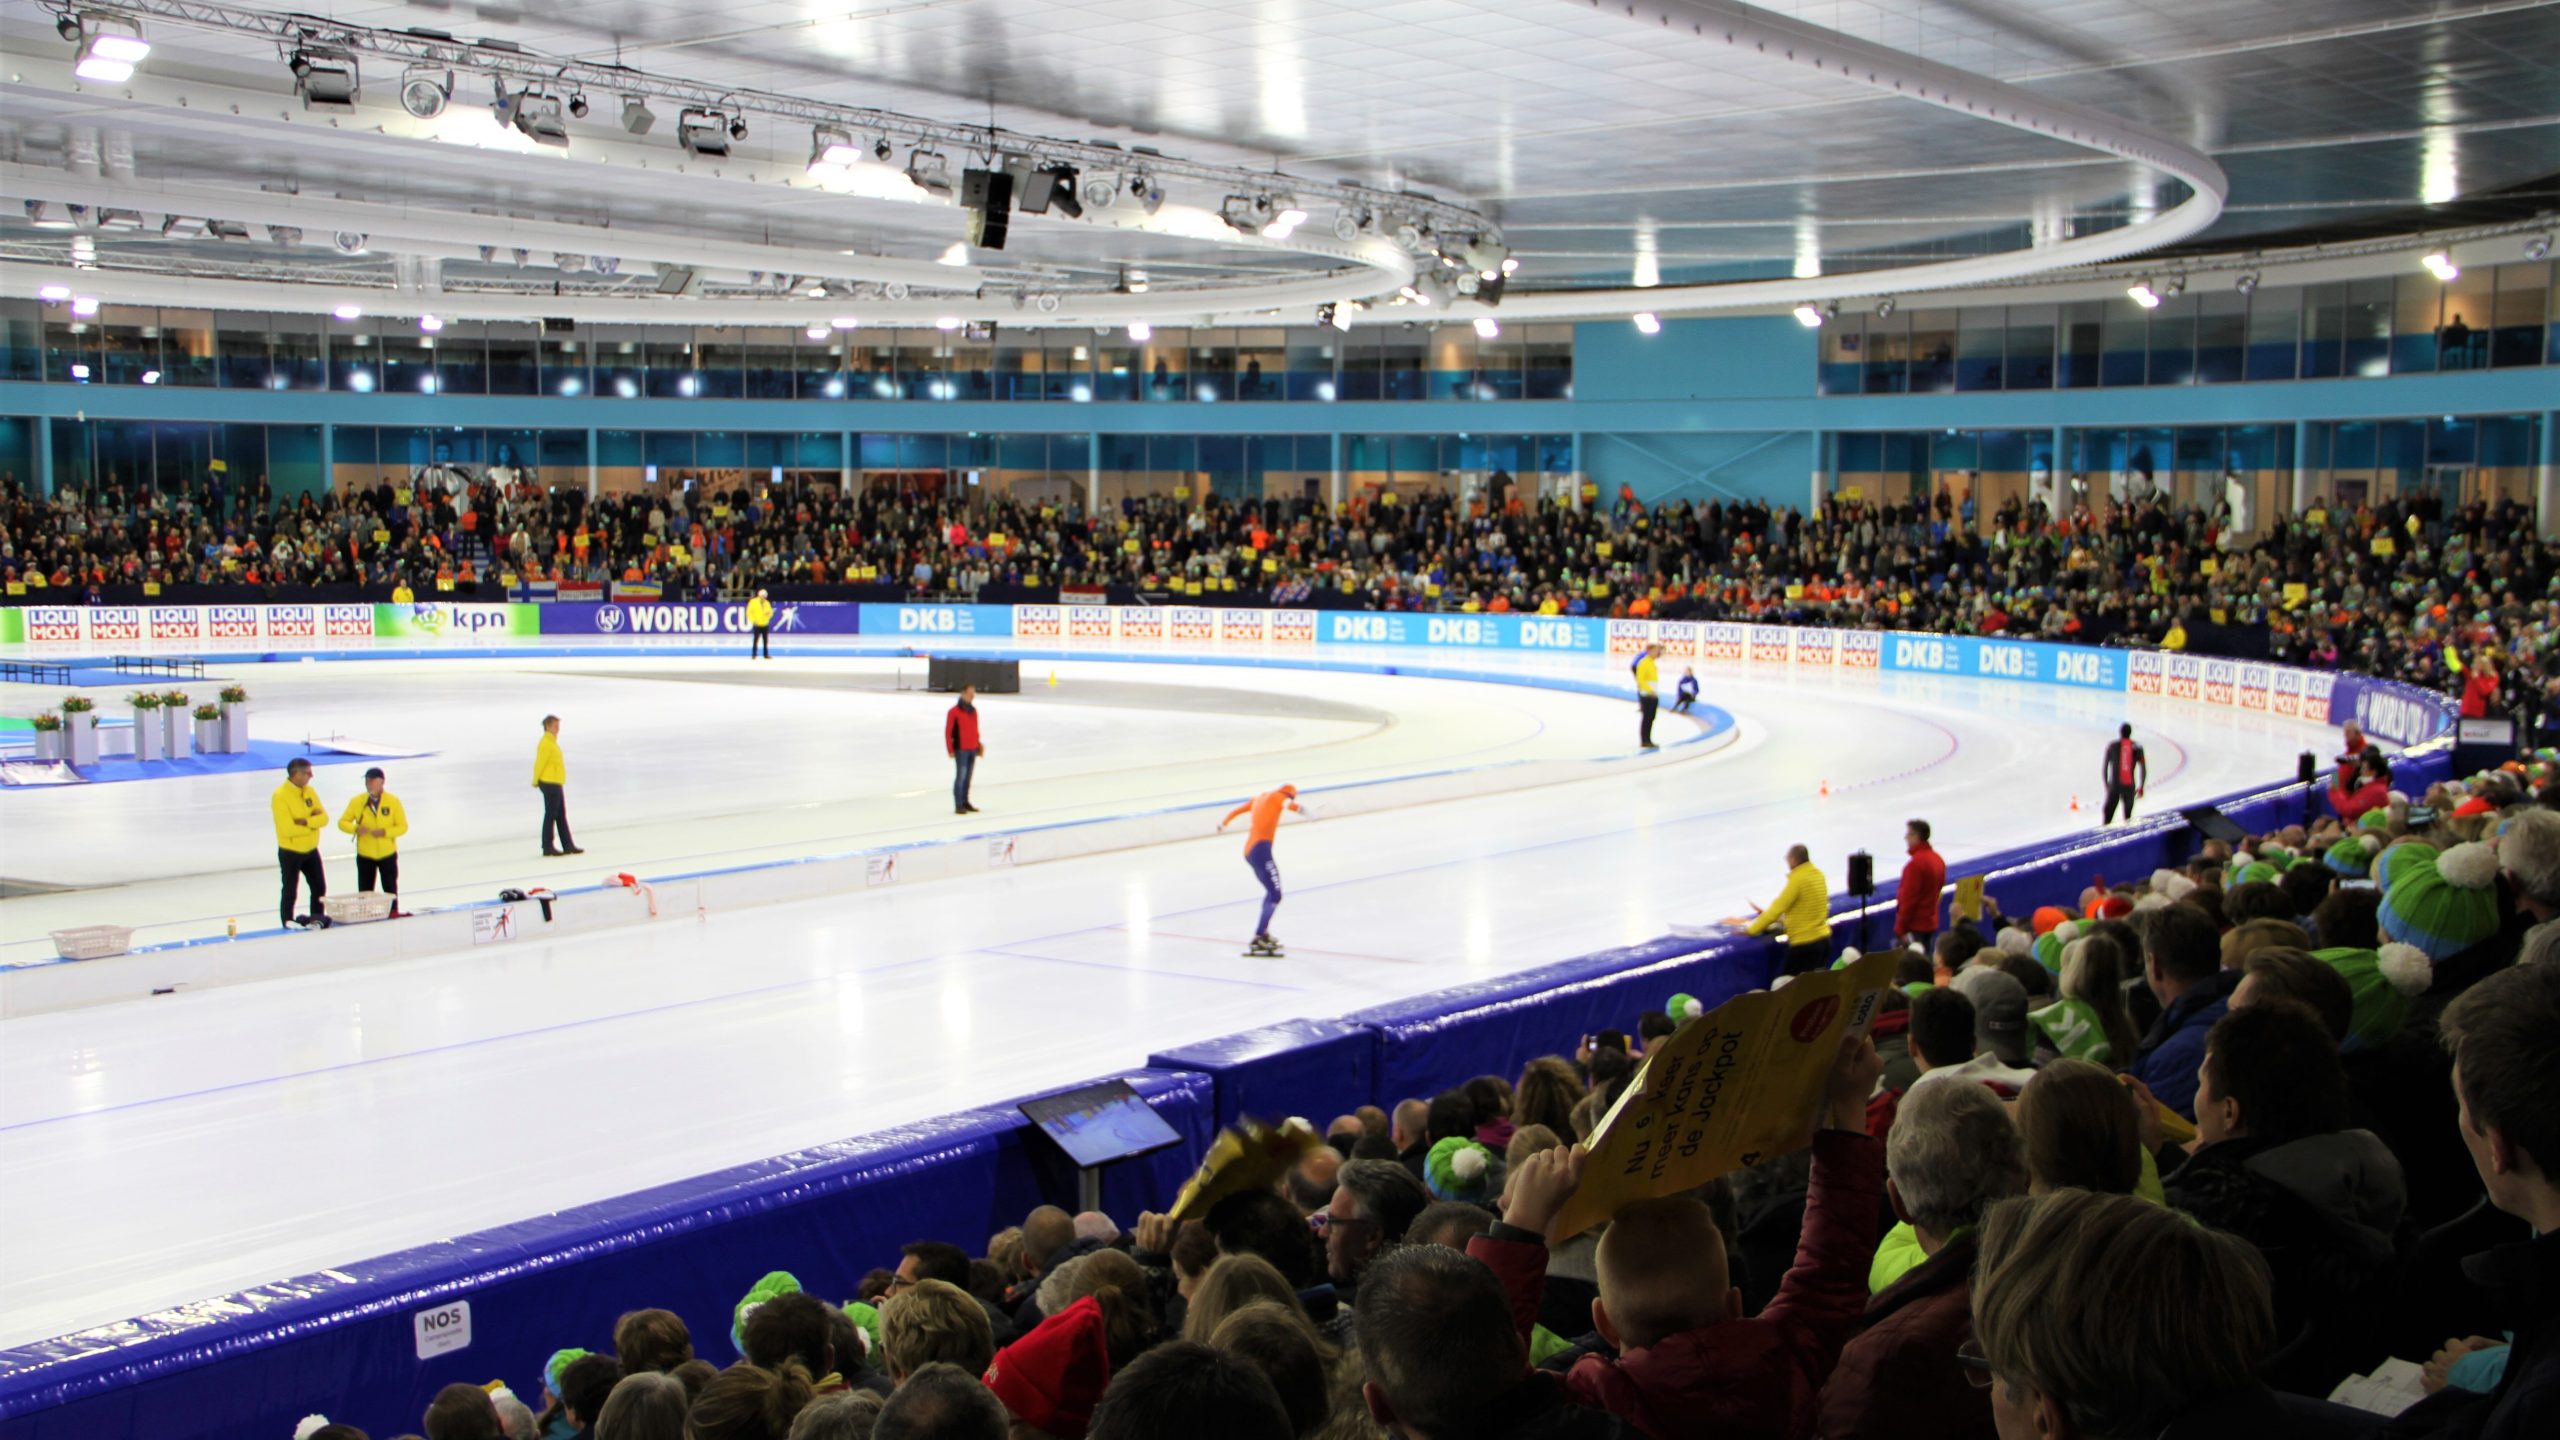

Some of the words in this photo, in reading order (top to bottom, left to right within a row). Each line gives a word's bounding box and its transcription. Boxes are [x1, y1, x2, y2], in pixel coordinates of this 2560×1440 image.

[31, 610, 77, 624] LIQUI
[92, 610, 138, 624] LIQUI
[152, 609, 197, 623] LIQUI
[211, 608, 255, 622] LIQUI
[269, 608, 313, 621] LIQUI
[327, 608, 369, 620] LIQUI
[453, 608, 506, 632] kpn
[629, 606, 719, 632] WORLD
[723, 606, 754, 632] CU
[900, 607, 956, 632] DKB
[1020, 607, 1059, 620] LIQUI
[1071, 607, 1110, 621] LIQUI
[1122, 608, 1161, 621] LIQUI
[1172, 609, 1212, 623] LIQUI
[1223, 610, 1262, 624] LIQUI
[1273, 611, 1312, 625] LIQUI
[32, 625, 79, 639] MOLY
[92, 625, 139, 638] MOLY
[152, 624, 199, 637] MOLY
[212, 623, 257, 636] MOLY
[270, 622, 314, 635] MOLY
[327, 622, 371, 635] MOLY
[1019, 622, 1060, 634] MOLY
[1071, 622, 1110, 635] MOLY
[1122, 623, 1161, 636] MOLY
[1172, 624, 1212, 637] MOLY
[1223, 625, 1262, 638] MOLY
[1273, 626, 1312, 639] MOLY
[1334, 616, 1387, 641] DKB
[1428, 618, 1481, 643] DKB
[1520, 621, 1572, 647] DKB
[1612, 622, 1648, 638] LIQUI
[1659, 624, 1694, 640] LIQUI
[1705, 626, 1741, 642] LIQUI
[1752, 629, 1787, 645] LIQUI
[1798, 631, 1832, 648] LIQUI
[1843, 634, 1878, 650] LIQUI
[1705, 643, 1741, 657] MOLY
[1752, 646, 1787, 660] MOLY
[1798, 648, 1832, 663] MOLY
[1842, 650, 1877, 666] MOLY
[1895, 640, 1943, 669] DKB
[1979, 645, 2024, 675] DKB
[2056, 651, 2099, 683] DKB
[2132, 653, 2161, 673] LIQUI
[2170, 657, 2199, 678] LIQUI
[2207, 662, 2234, 683] LIQUI
[2241, 666, 2268, 687] LIQUI
[2131, 674, 2161, 693] MOLY
[2169, 678, 2198, 699] MOLY
[2275, 671, 2300, 692] LIQUI
[2306, 675, 2332, 697] LIQUI
[2206, 683, 2233, 704] MOLY
[2240, 688, 2266, 709] MOLY
[2274, 693, 2298, 715] MOLY
[2304, 698, 2329, 721] MOLY
[2369, 691, 2405, 740] WORLD
[1853, 993, 1876, 1026] Lotto
[1678, 1129, 1703, 1157] de
[1692, 1031, 1743, 1122] Jackpot
[1651, 1123, 1680, 1179] meer
[1666, 1061, 1700, 1117] kans
[1698, 1027, 1718, 1056] op
[1624, 1140, 1650, 1175] Nu
[1648, 1056, 1684, 1102] keer
[424, 1308, 461, 1332] NOS
